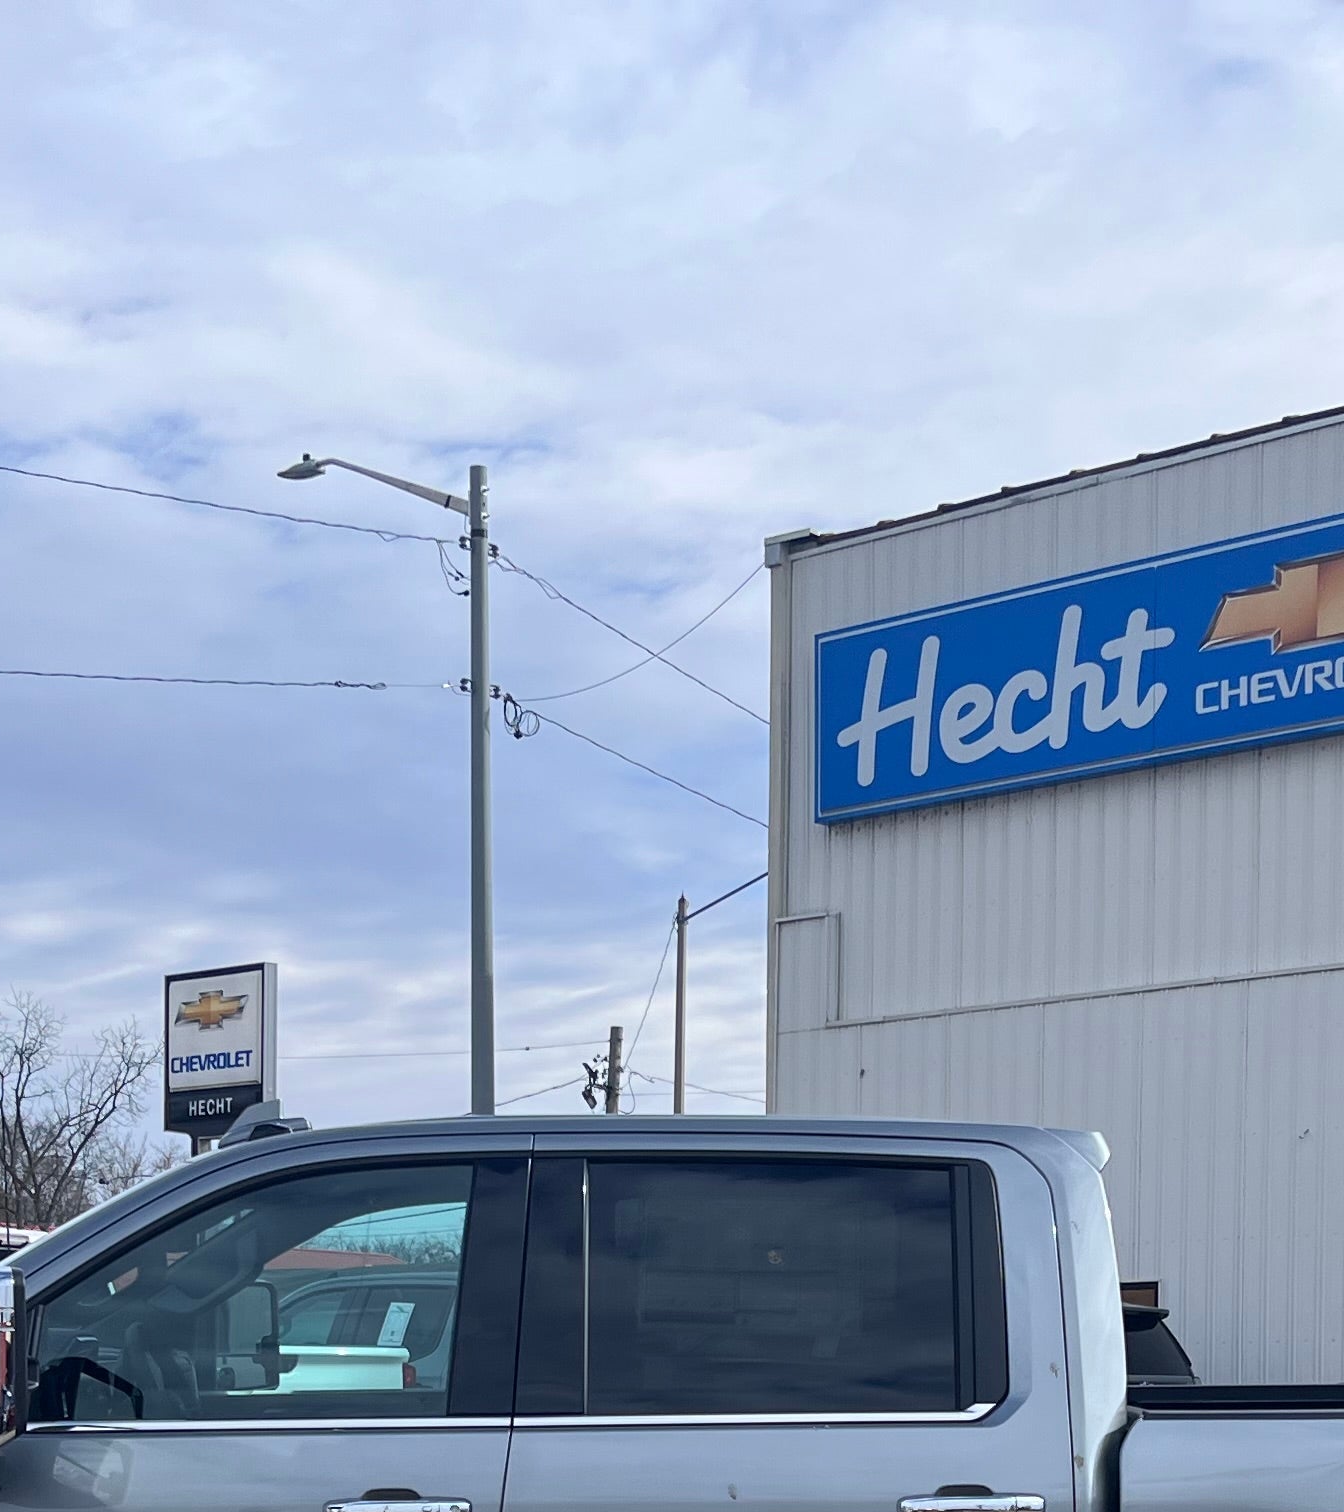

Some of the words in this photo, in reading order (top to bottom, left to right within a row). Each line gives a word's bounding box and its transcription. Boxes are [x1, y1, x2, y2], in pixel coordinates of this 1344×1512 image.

[837, 603, 1175, 787] Hecht
[170, 1050, 253, 1074] CHEVROLET
[188, 1097, 233, 1117] HECHT
